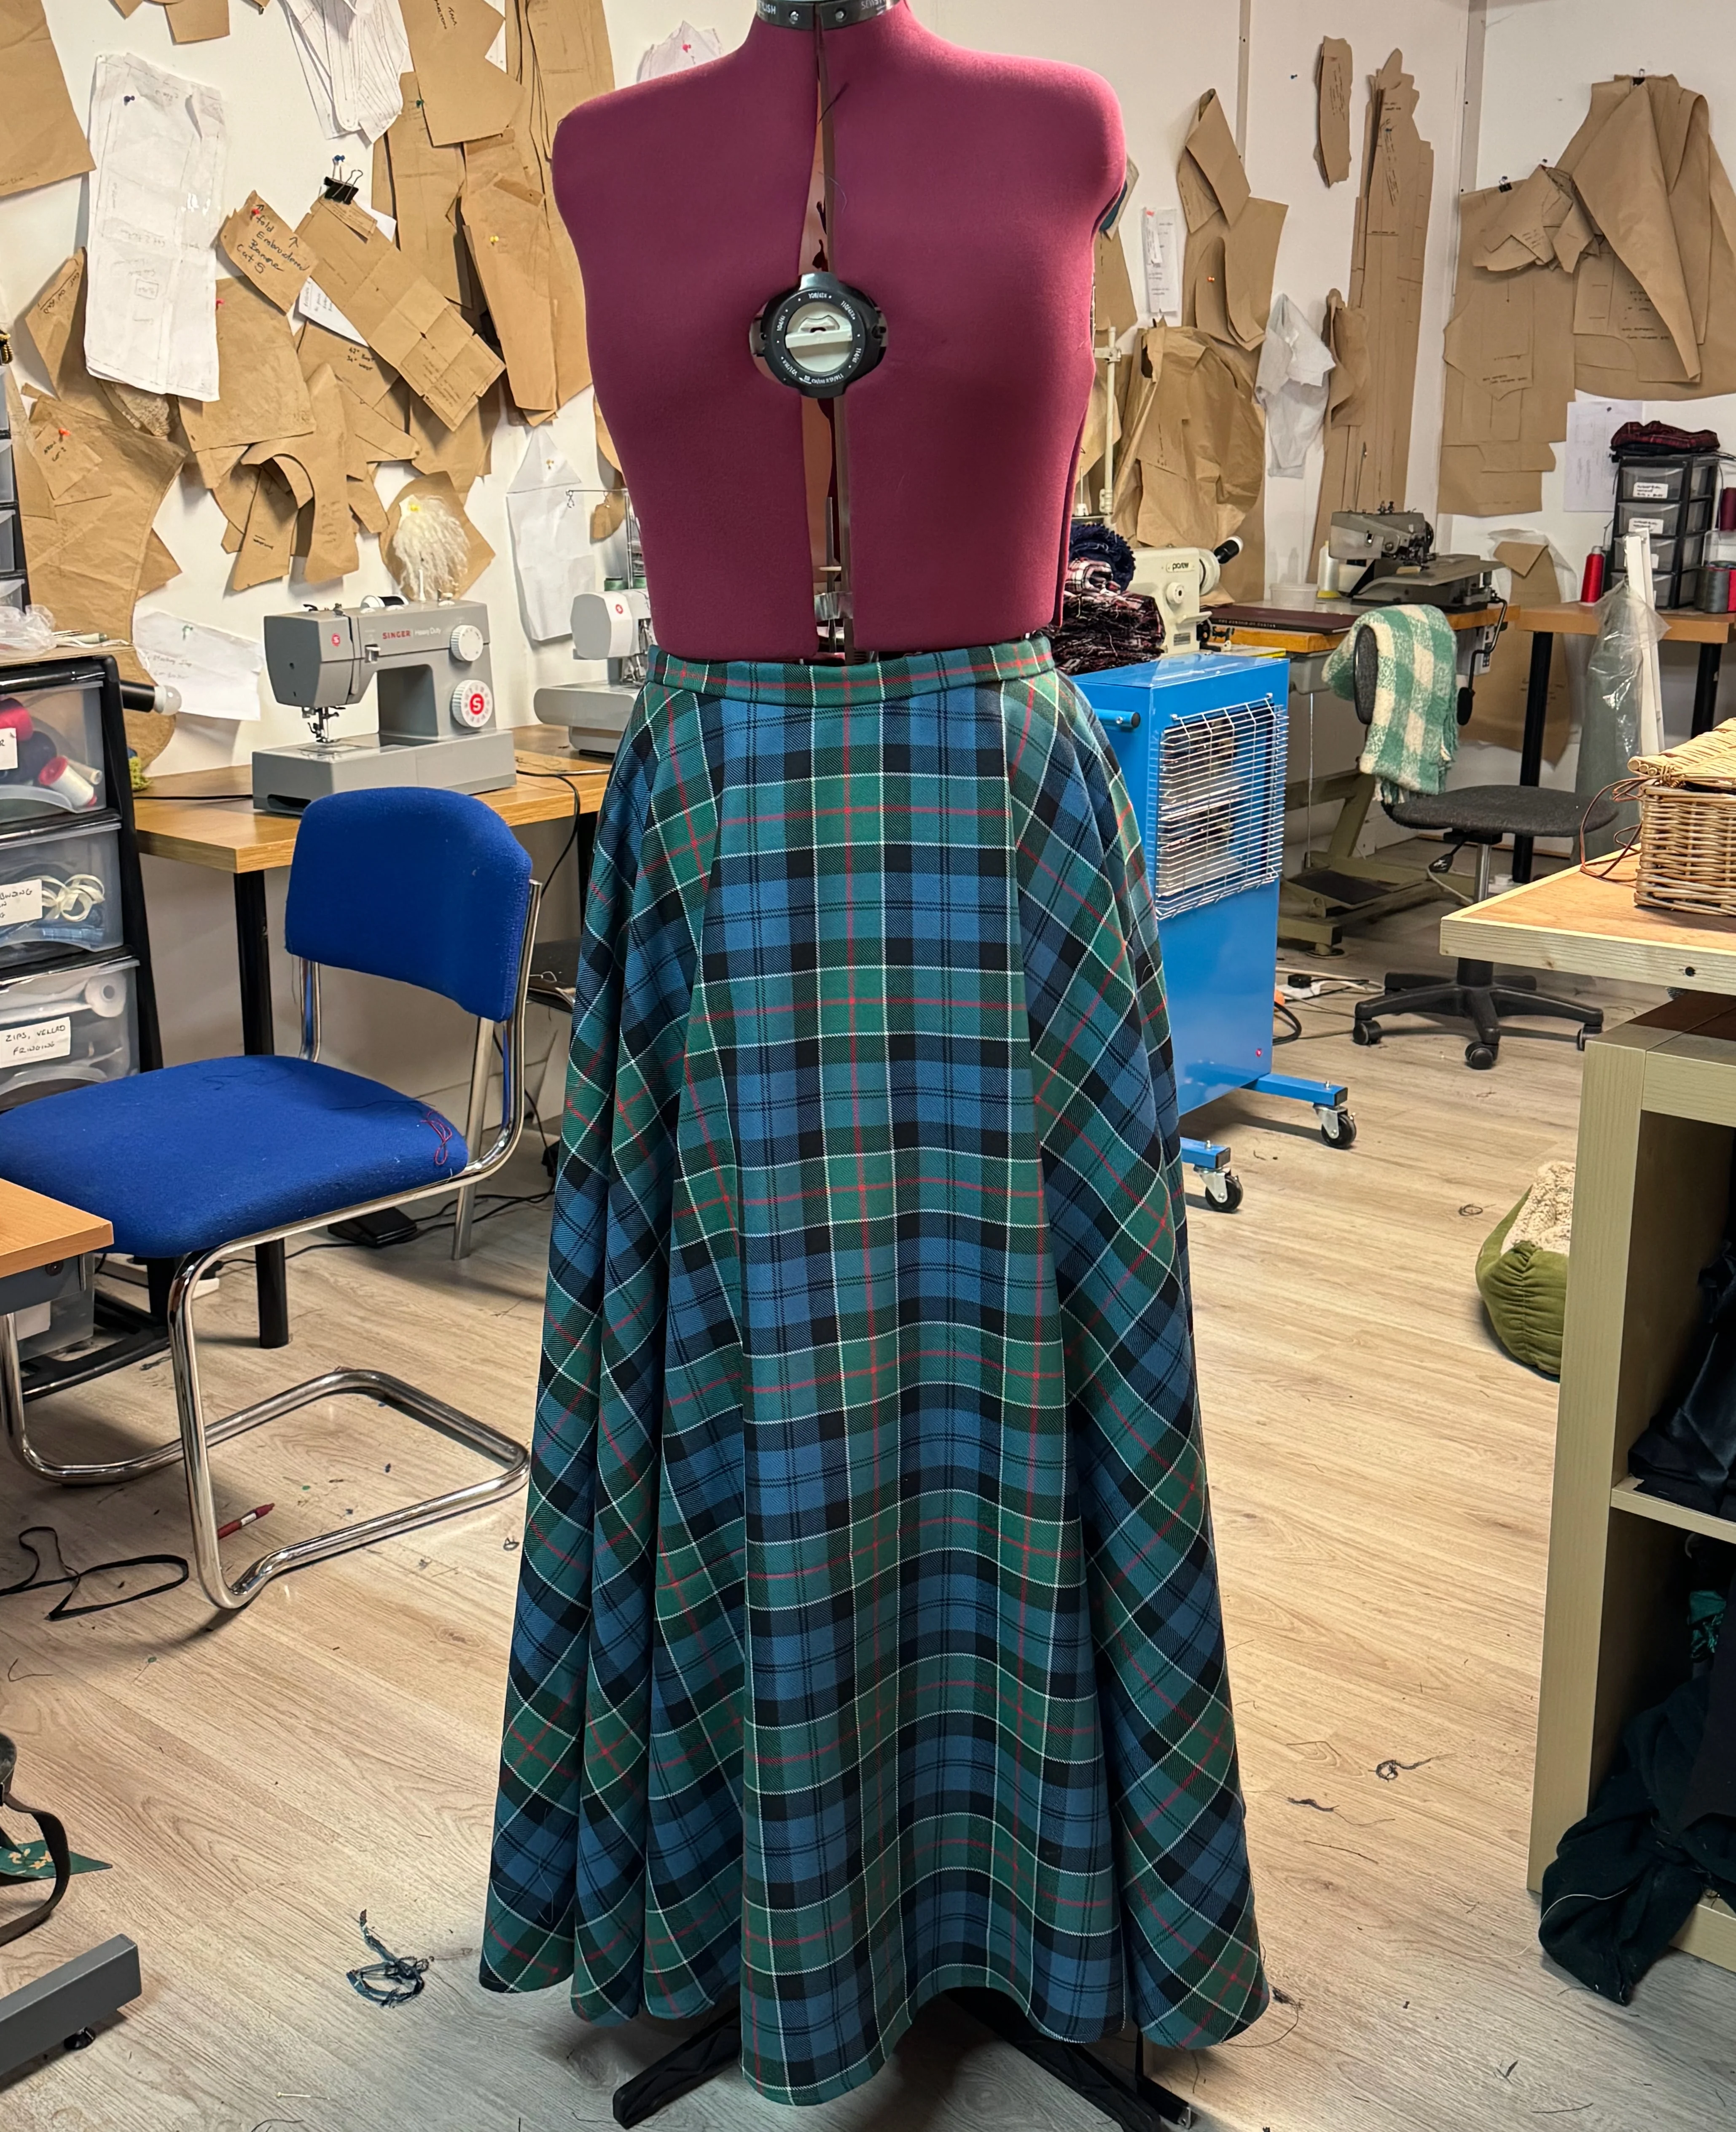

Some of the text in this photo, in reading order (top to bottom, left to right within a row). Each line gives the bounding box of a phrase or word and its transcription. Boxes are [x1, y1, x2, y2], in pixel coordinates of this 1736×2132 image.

[256, 215, 274, 232] fold
[236, 244, 254, 262] Cut
[382, 630, 411, 640] SINGER
[472, 697, 481, 711] S
